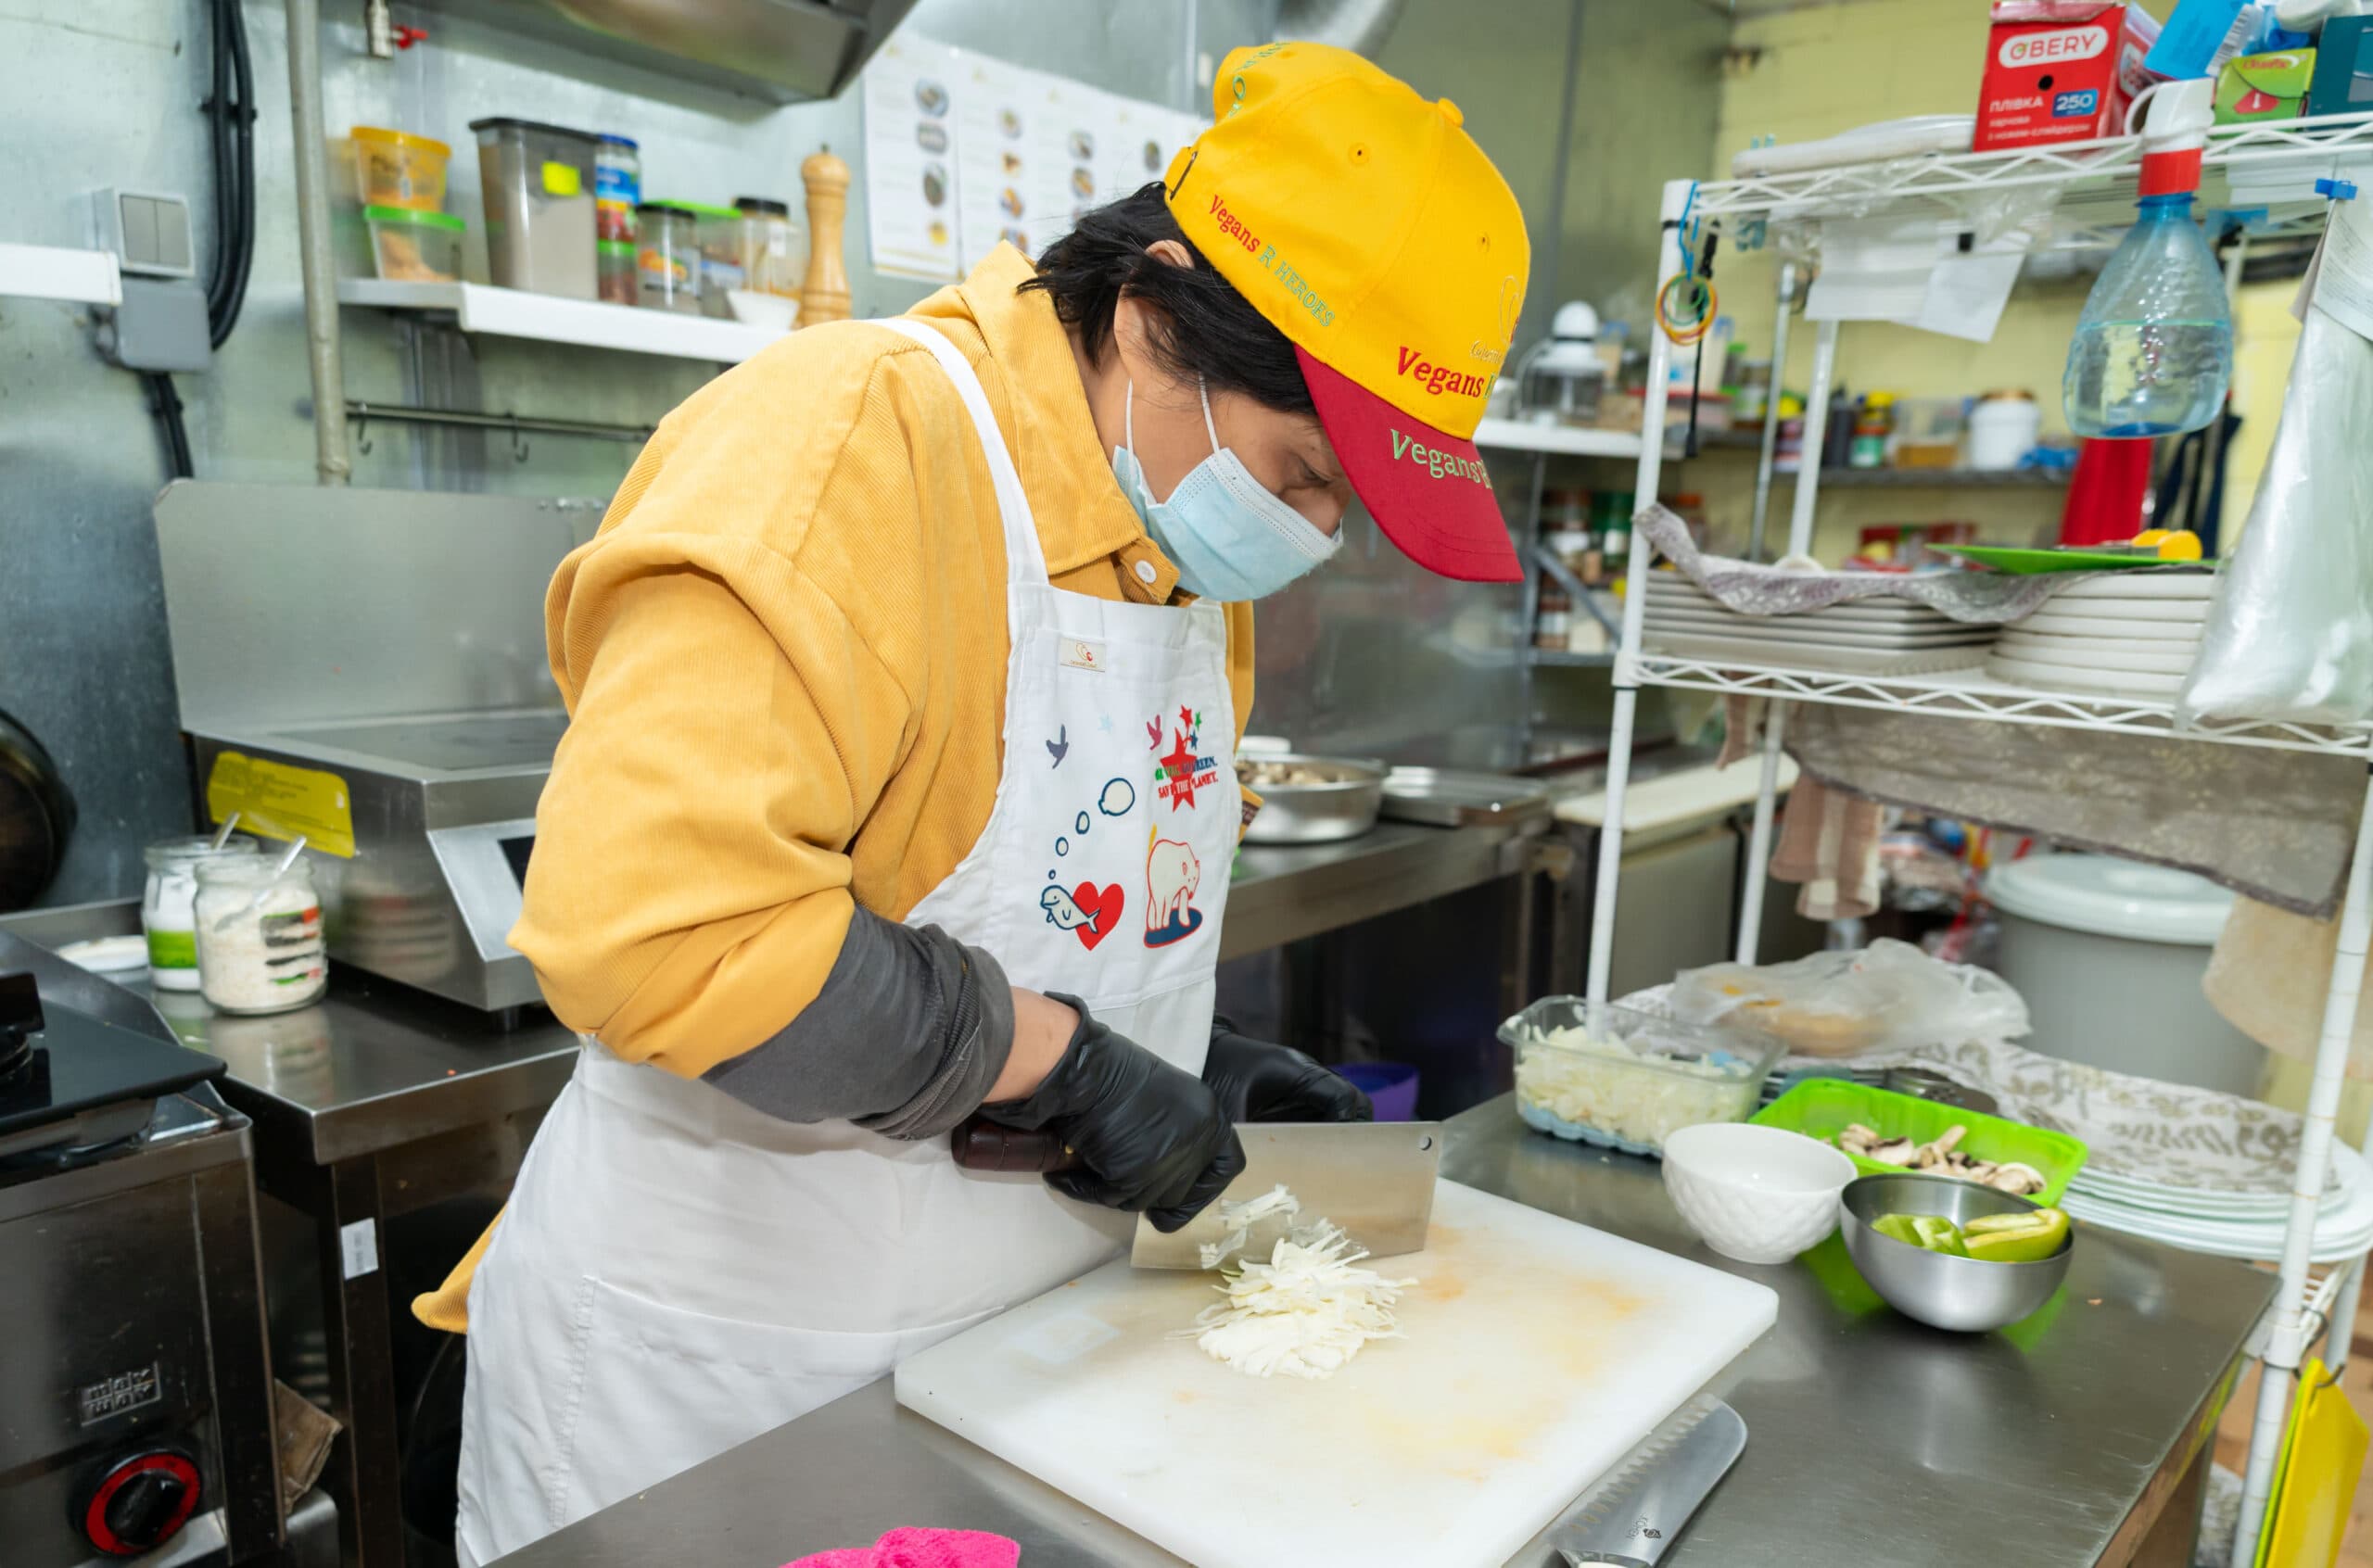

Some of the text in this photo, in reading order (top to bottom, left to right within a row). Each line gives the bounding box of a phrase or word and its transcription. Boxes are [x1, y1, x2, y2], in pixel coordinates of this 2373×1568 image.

[2010, 34, 2097, 60] OBERY
[1989, 96, 2043, 112] ПЛІВКА
[2056, 94, 2093, 110] 250
[1209, 194, 1336, 327] Vegans R HEROES
[1396, 346, 1485, 398] Vegans
[1390, 428, 1481, 484] Vegans
